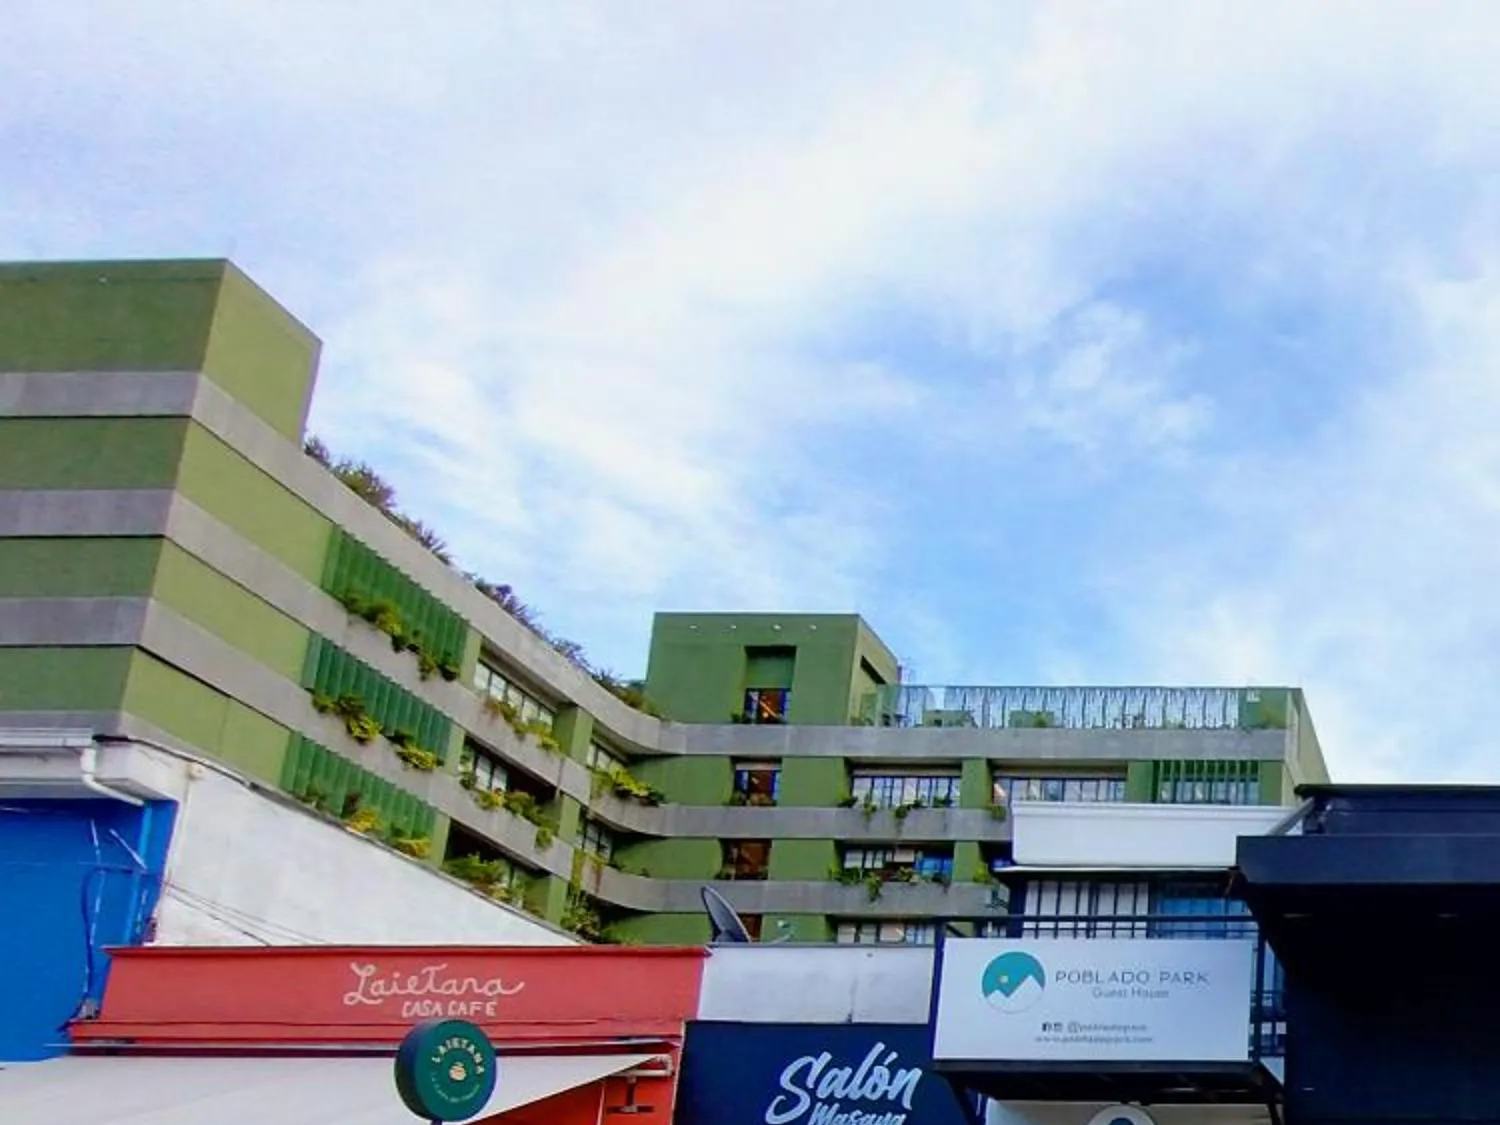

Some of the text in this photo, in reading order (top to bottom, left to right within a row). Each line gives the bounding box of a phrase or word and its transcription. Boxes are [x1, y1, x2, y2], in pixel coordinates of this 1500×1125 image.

[1055, 970, 1211, 985] POBLADO PARK
[1131, 987, 1170, 999] House
[402, 999, 444, 1018] CASA
[765, 1042, 923, 1125] Salón
